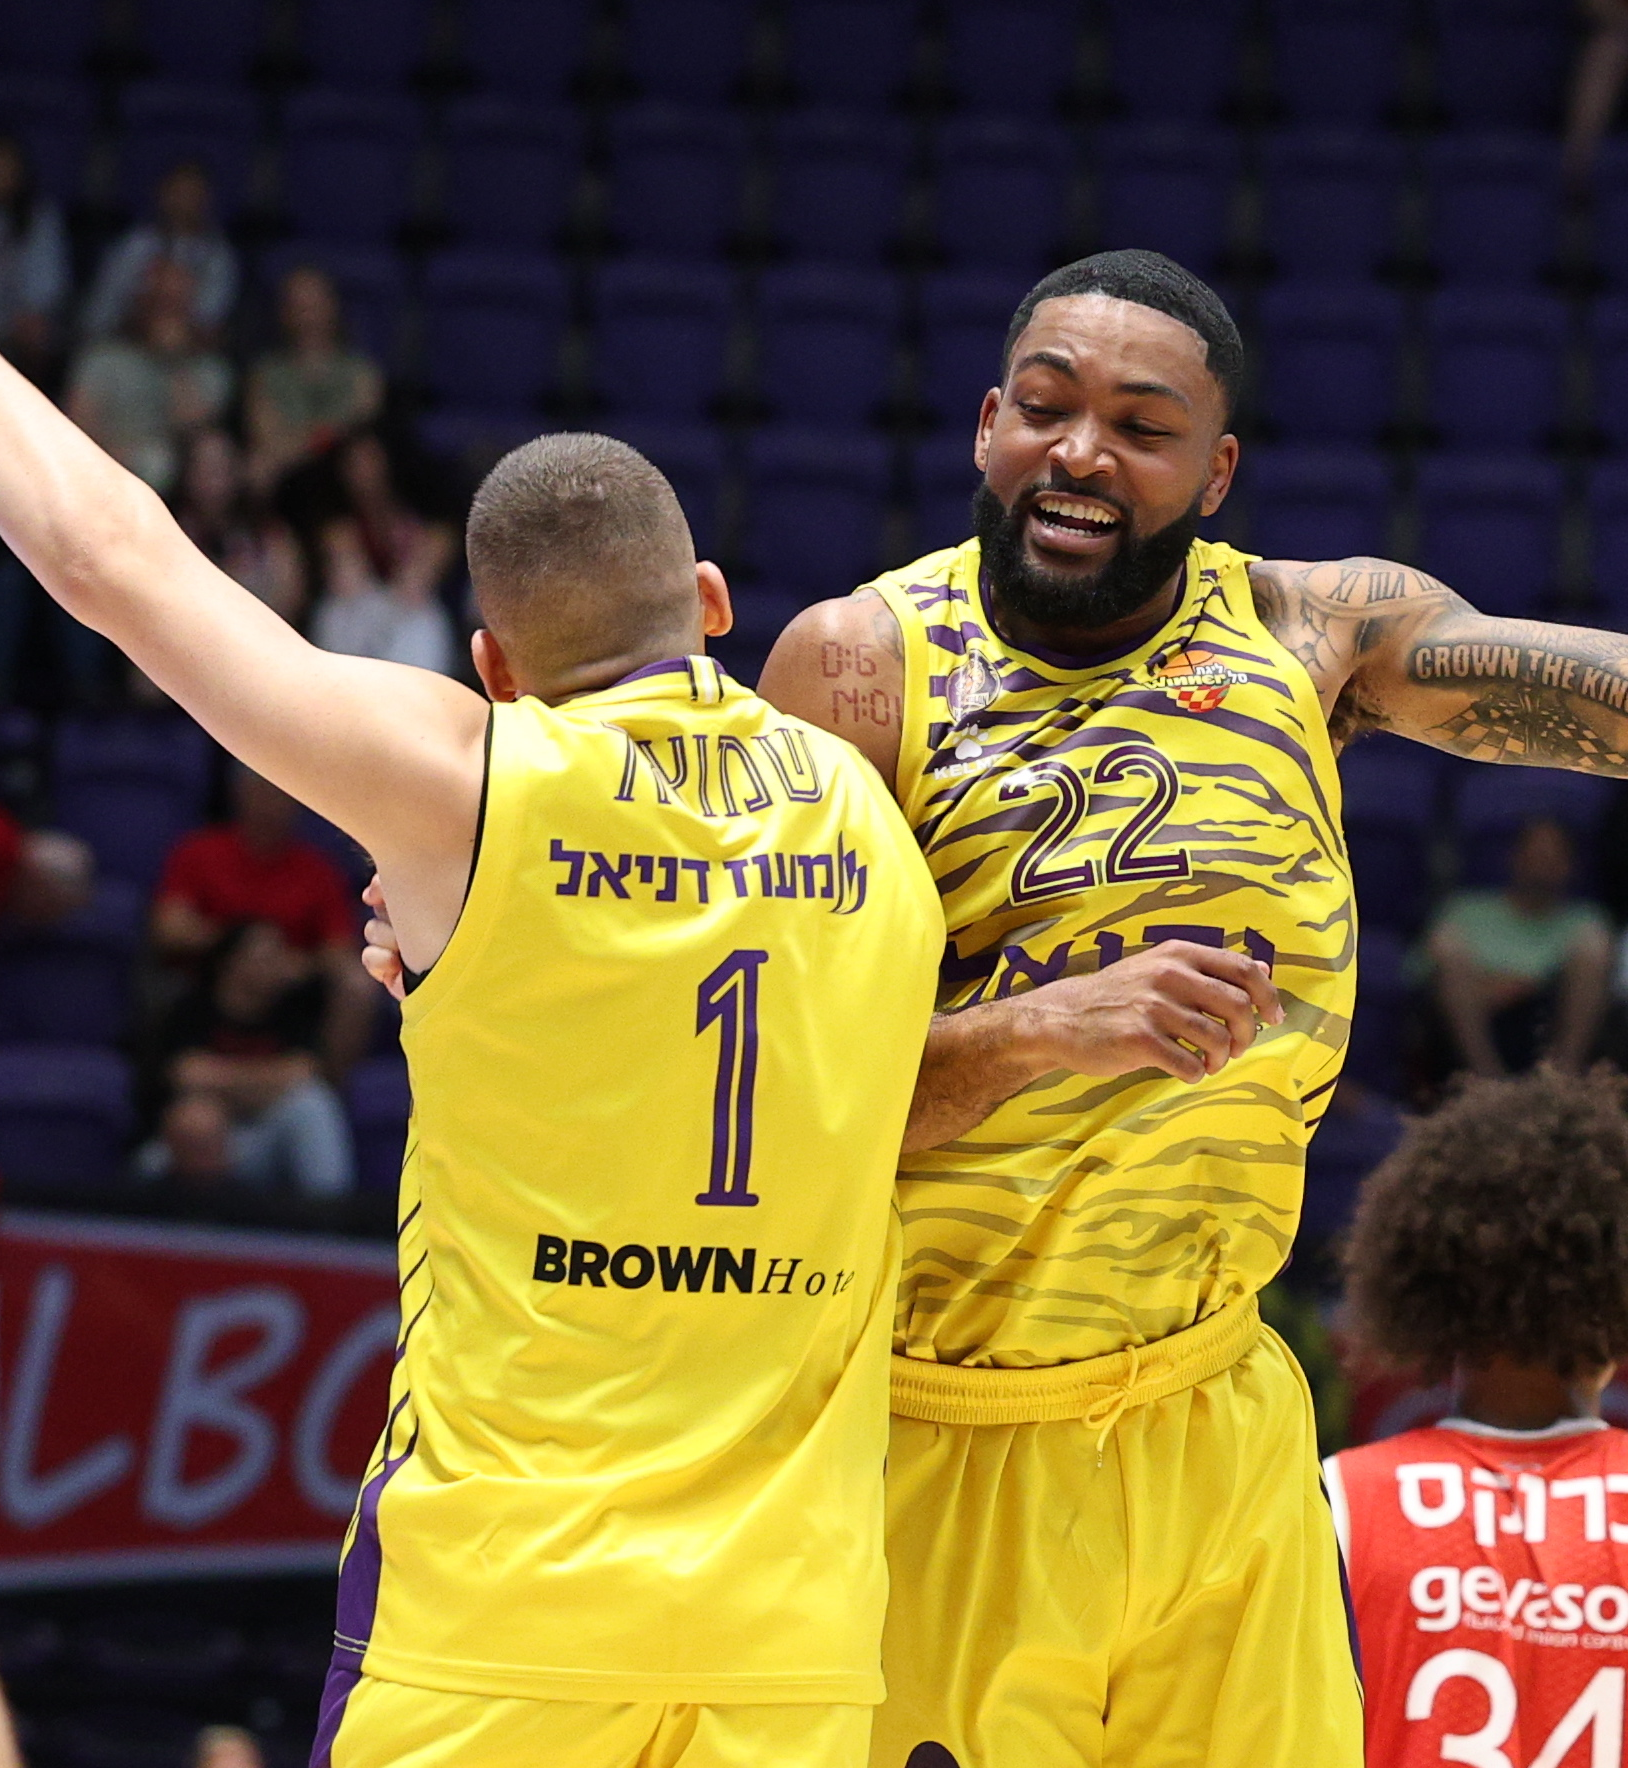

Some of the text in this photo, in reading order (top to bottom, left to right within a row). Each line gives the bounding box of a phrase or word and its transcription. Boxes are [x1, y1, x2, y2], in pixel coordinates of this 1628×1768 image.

[1415, 644, 1520, 680] CROWN
[1527, 648, 1579, 689] THE
[998, 742, 1192, 906] 22
[549, 838, 835, 904] מעוז דניאל
[696, 949, 769, 1207] 1
[533, 1234, 856, 1297] BROWN Hote
